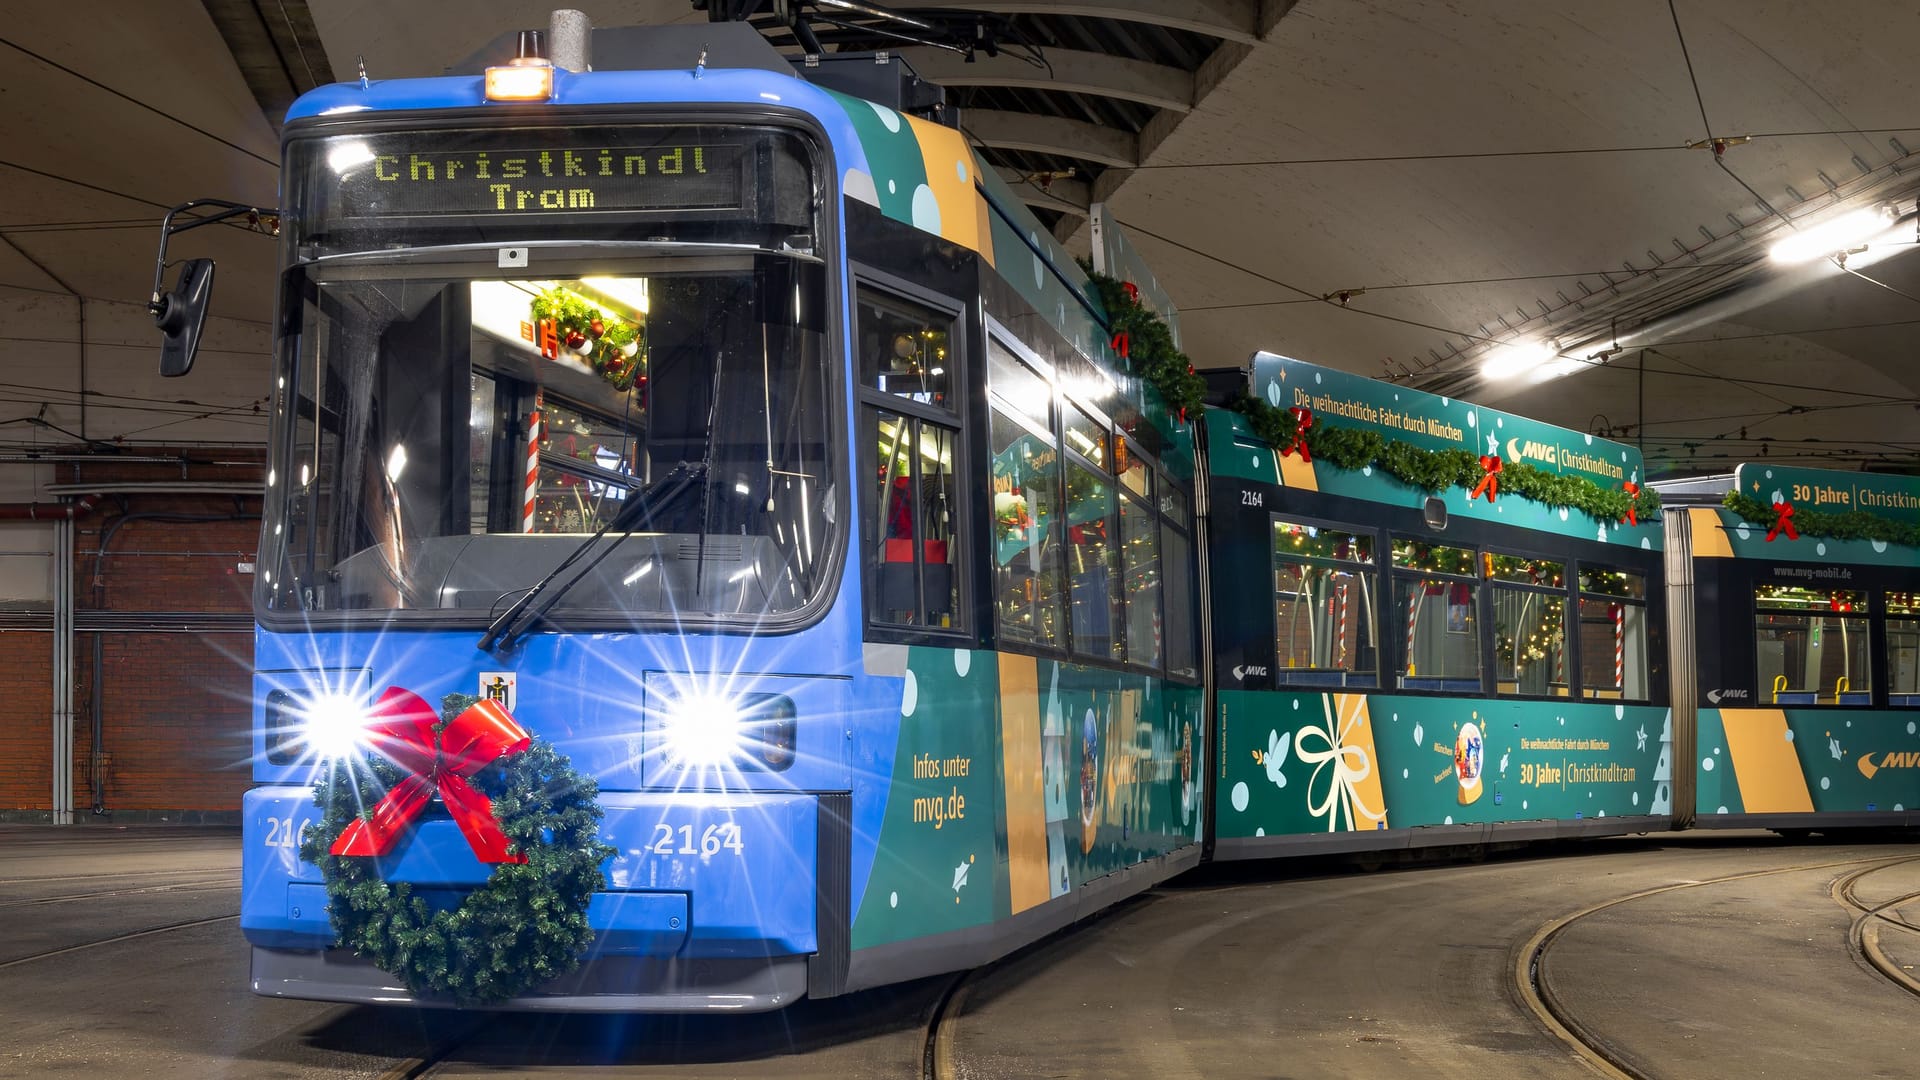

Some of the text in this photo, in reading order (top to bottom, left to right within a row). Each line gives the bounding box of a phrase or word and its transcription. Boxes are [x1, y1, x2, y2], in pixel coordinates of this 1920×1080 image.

[375, 147, 706, 181] Christkindl
[489, 183, 595, 210] Tram
[1294, 387, 1463, 442] Die weihnachtliche Fahrt durch München
[1521, 440, 1623, 479] MVG Christkindltram
[1241, 490, 1263, 507] 2164
[1792, 484, 1920, 509] 30 Jahre Christkin
[1773, 567, 1852, 580] www.mvg-mobil.de
[1245, 665, 1267, 677] MVG
[1722, 689, 1748, 698] MVG
[914, 752, 971, 779] Infos unter
[1520, 762, 1636, 788] 30 Jahre Christkindltram
[914, 785, 965, 829] mvg.de
[264, 817, 311, 849] 216
[653, 823, 744, 856] 2164
